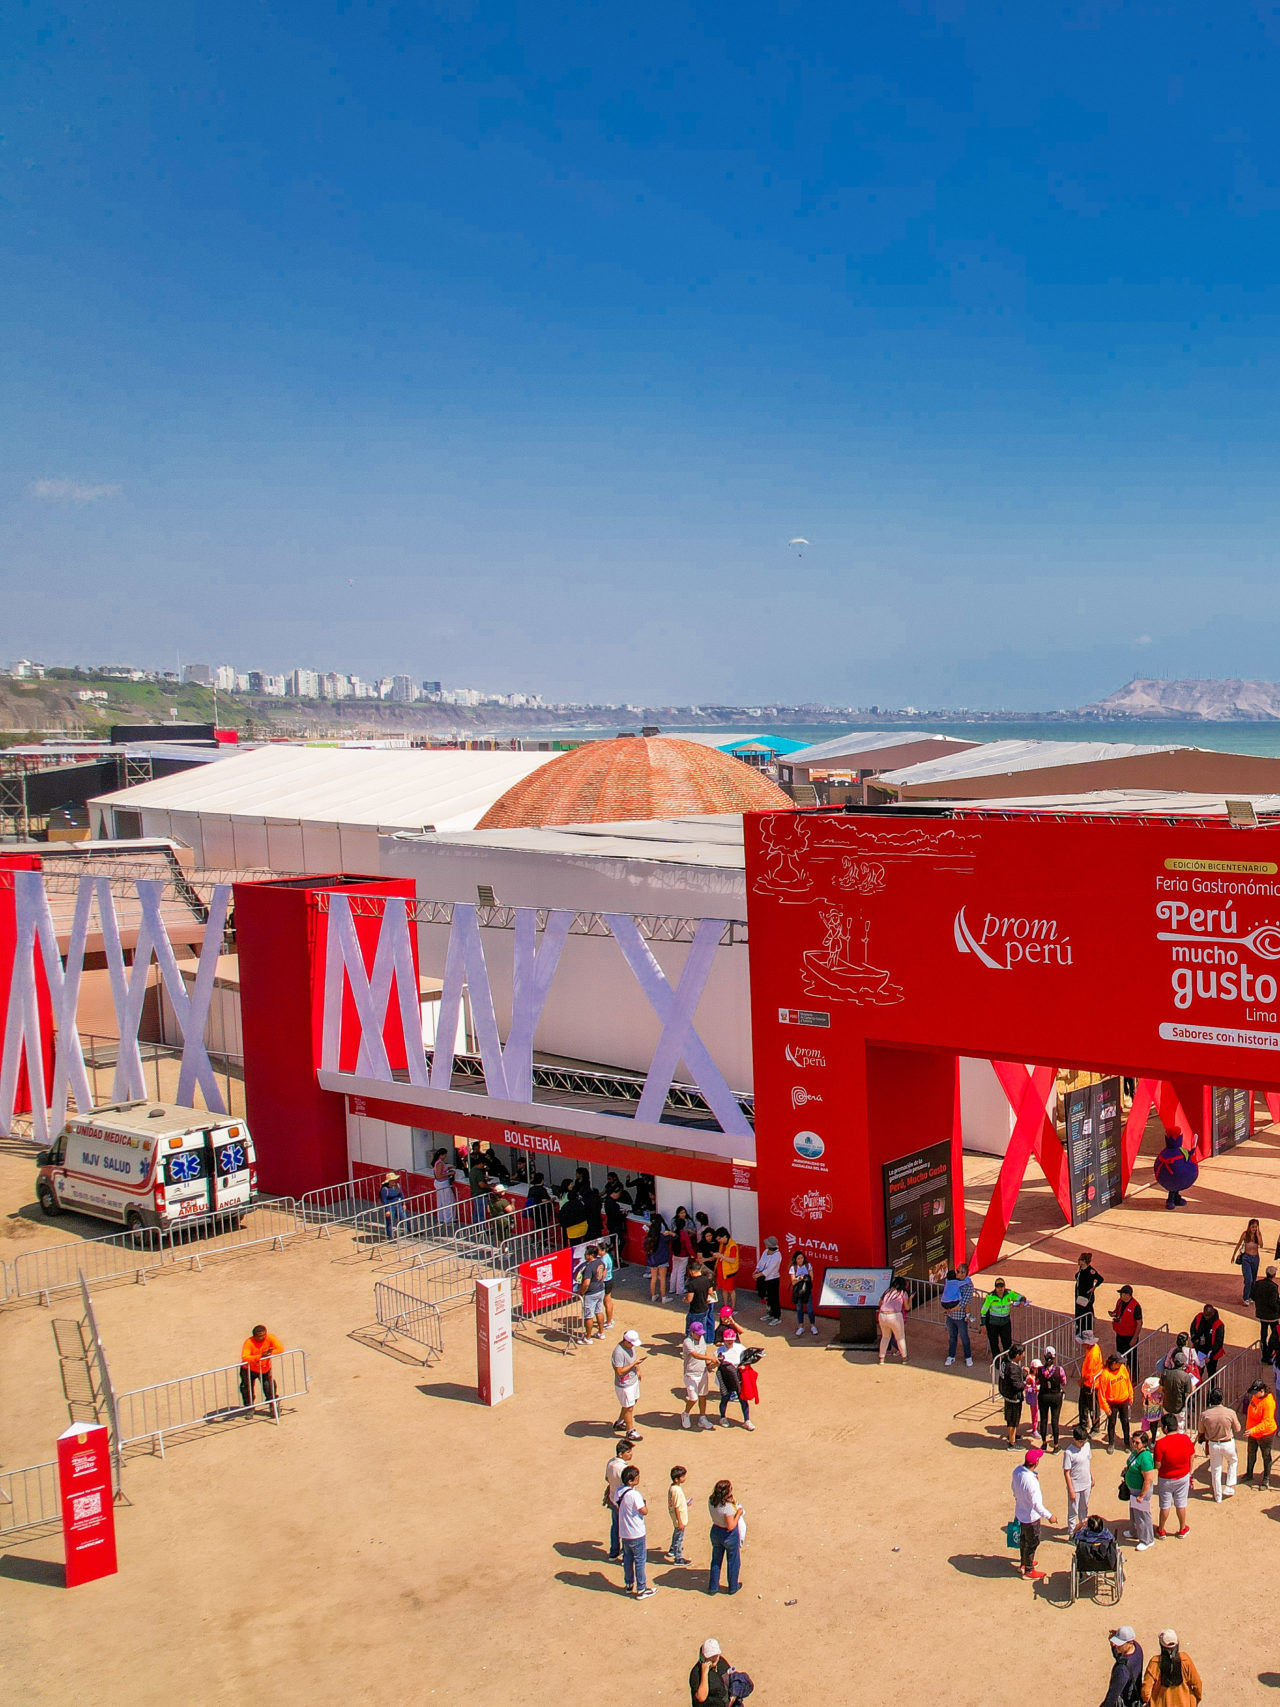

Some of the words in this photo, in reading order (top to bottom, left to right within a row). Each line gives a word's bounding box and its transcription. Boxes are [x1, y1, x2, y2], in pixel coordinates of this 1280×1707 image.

[1173, 860, 1206, 870] EDICIÓN
[1208, 863, 1268, 872] BICENTENARIO
[1156, 876, 1188, 892] Feria
[1156, 900, 1237, 934] Perú
[978, 913, 1058, 944] prom
[1004, 936, 1074, 970] perú
[1172, 946, 1238, 965] mucho
[1172, 964, 1278, 1009] gusto
[1246, 1008, 1277, 1022] Lima
[1172, 1027, 1213, 1041] Sabores
[1216, 1032, 1234, 1042] con
[1237, 1033, 1278, 1047] historia
[794, 1046, 821, 1058] prom
[803, 1056, 826, 1068] perú
[76, 1125, 102, 1139] UNIDAD
[104, 1131, 132, 1146] MEDICA
[504, 1129, 562, 1153] BOLETERÍA
[83, 1152, 100, 1166] MJV
[104, 1156, 131, 1174] SALUD
[907, 1172, 928, 1186] Mucho
[929, 1164, 947, 1177] Gusto
[799, 1237, 839, 1252] LATAM
[804, 1250, 839, 1262] IRLINES
